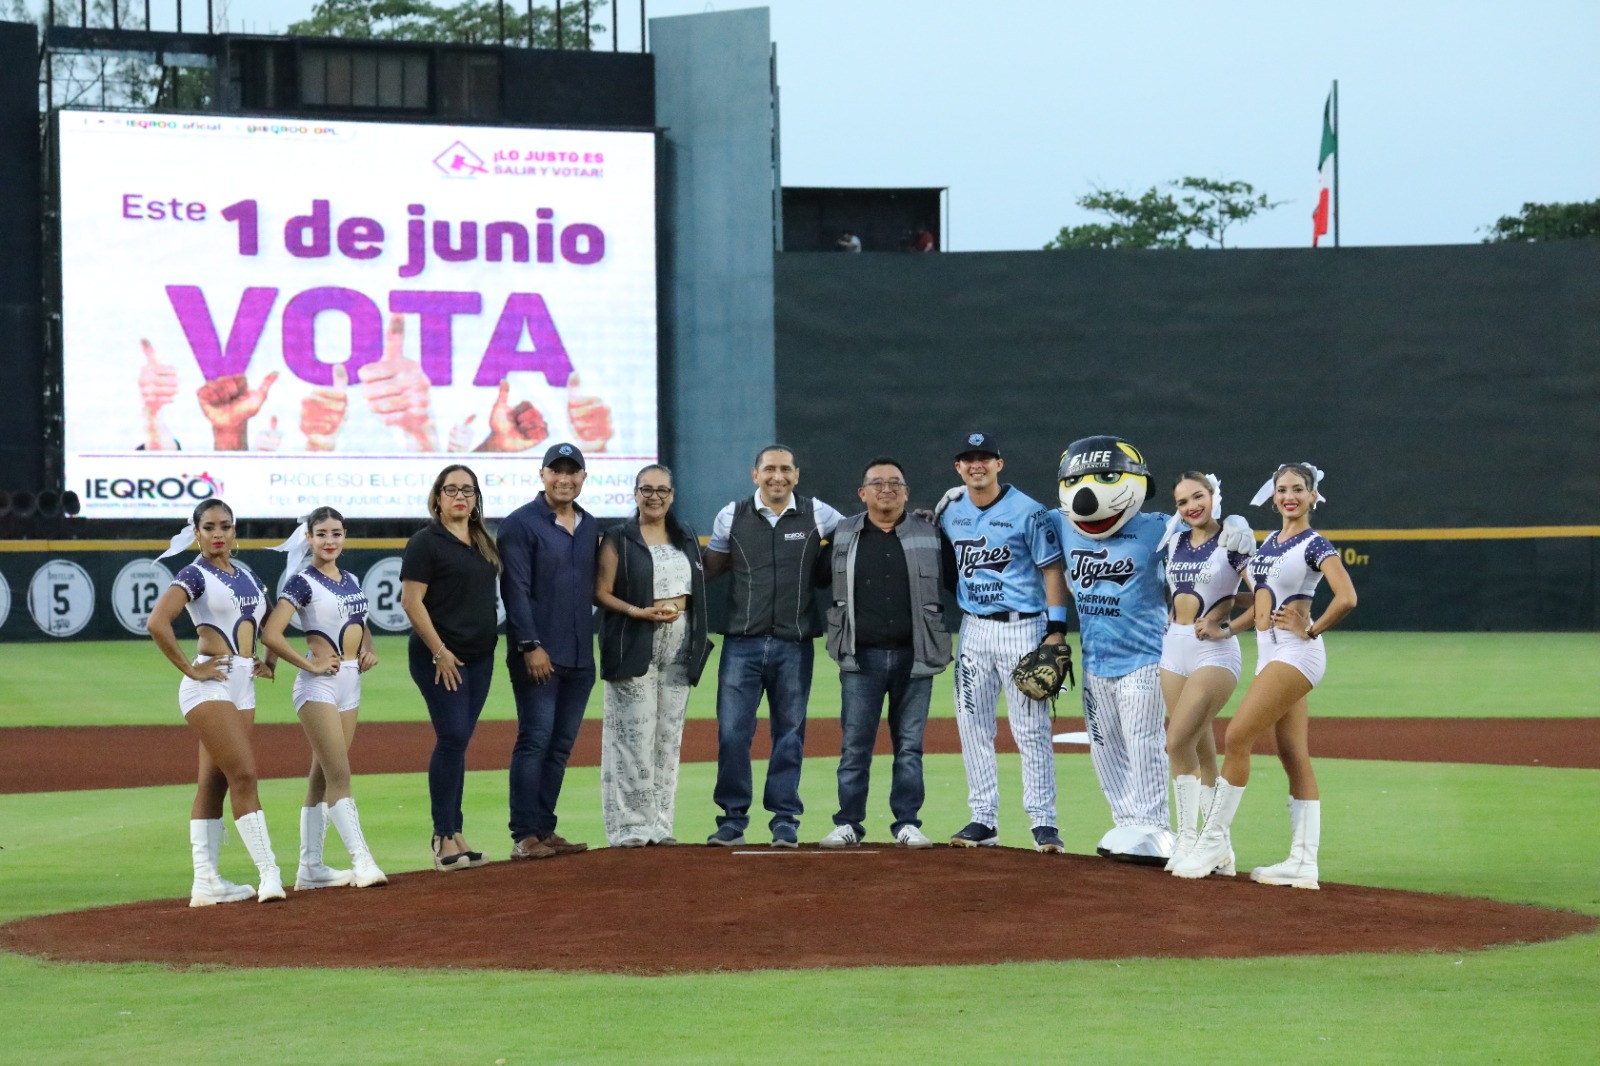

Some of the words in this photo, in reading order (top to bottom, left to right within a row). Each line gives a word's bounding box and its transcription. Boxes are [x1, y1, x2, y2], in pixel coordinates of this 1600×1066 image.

[524, 151, 580, 163] JUSTO
[583, 153, 604, 164] ES
[494, 165, 537, 175] SALIR
[541, 167, 550, 176] Y
[552, 168, 604, 178] VOTAR!
[121, 193, 207, 221] Este
[220, 199, 259, 256] 1
[284, 199, 386, 259] de
[398, 203, 606, 277] junio
[164, 284, 580, 388] VOTA
[1081, 450, 1112, 464] LIFE
[85, 477, 215, 500] IEQROO
[269, 473, 364, 487] PROCESO
[603, 493, 635, 505] 202
[953, 534, 1013, 579] Tigres
[1069, 546, 1136, 589] Tigres
[53, 583, 70, 616] 5
[131, 582, 159, 614] 12
[1077, 591, 1121, 606] SHERWIN
